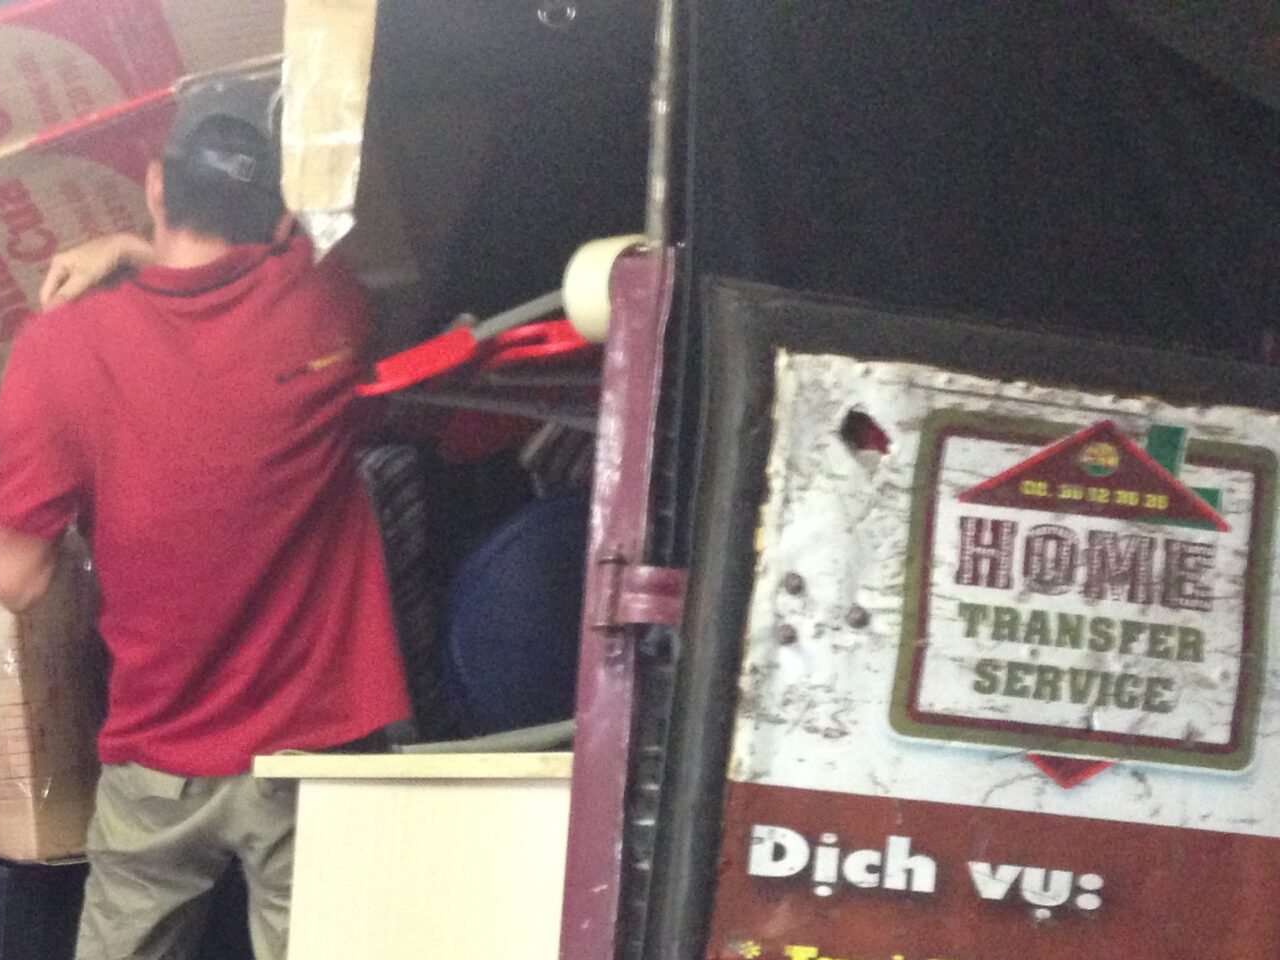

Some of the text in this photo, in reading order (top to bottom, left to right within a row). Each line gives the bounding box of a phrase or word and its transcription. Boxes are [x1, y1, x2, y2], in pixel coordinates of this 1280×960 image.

[954, 515, 1217, 613] HOME
[957, 602, 1205, 663] TRANSFER
[972, 658, 1177, 714] SERVICE
[747, 824, 1104, 920] Dịch vụ:
